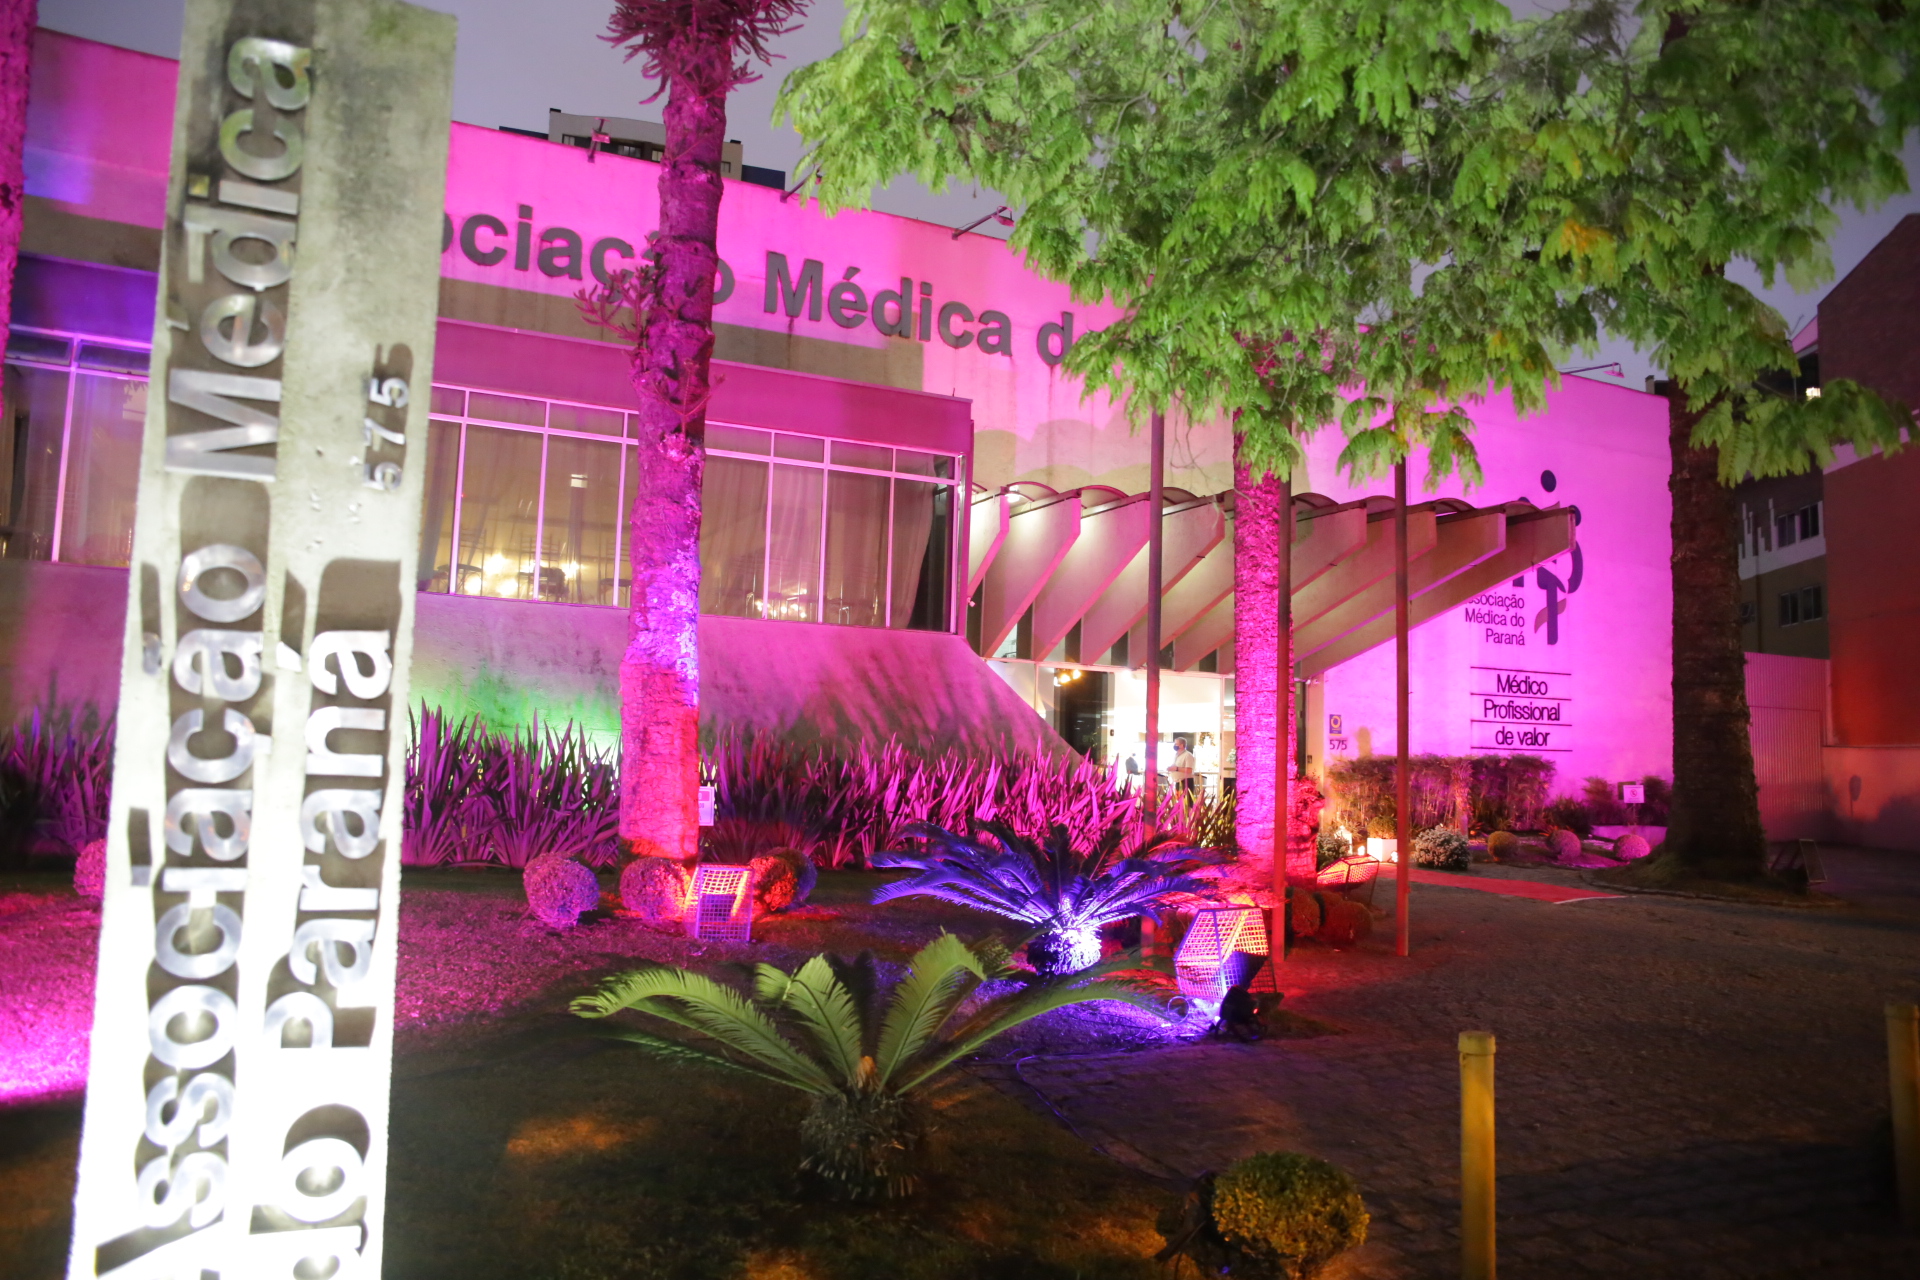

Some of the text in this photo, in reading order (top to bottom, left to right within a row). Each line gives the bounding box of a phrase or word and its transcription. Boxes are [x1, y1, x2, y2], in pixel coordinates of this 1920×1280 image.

[164, 36, 313, 482] Médica
[763, 250, 1013, 358] Médica
[361, 377, 409, 491] 575
[1468, 592, 1525, 612] sociação
[1465, 607, 1525, 628] Médica do
[1485, 628, 1525, 646] Paraná
[1497, 673, 1548, 696] Médico
[1484, 698, 1560, 722] Profissional
[1329, 739, 1347, 751] 575
[1495, 725, 1550, 747] de valor
[263, 630, 393, 1070] Paraná
